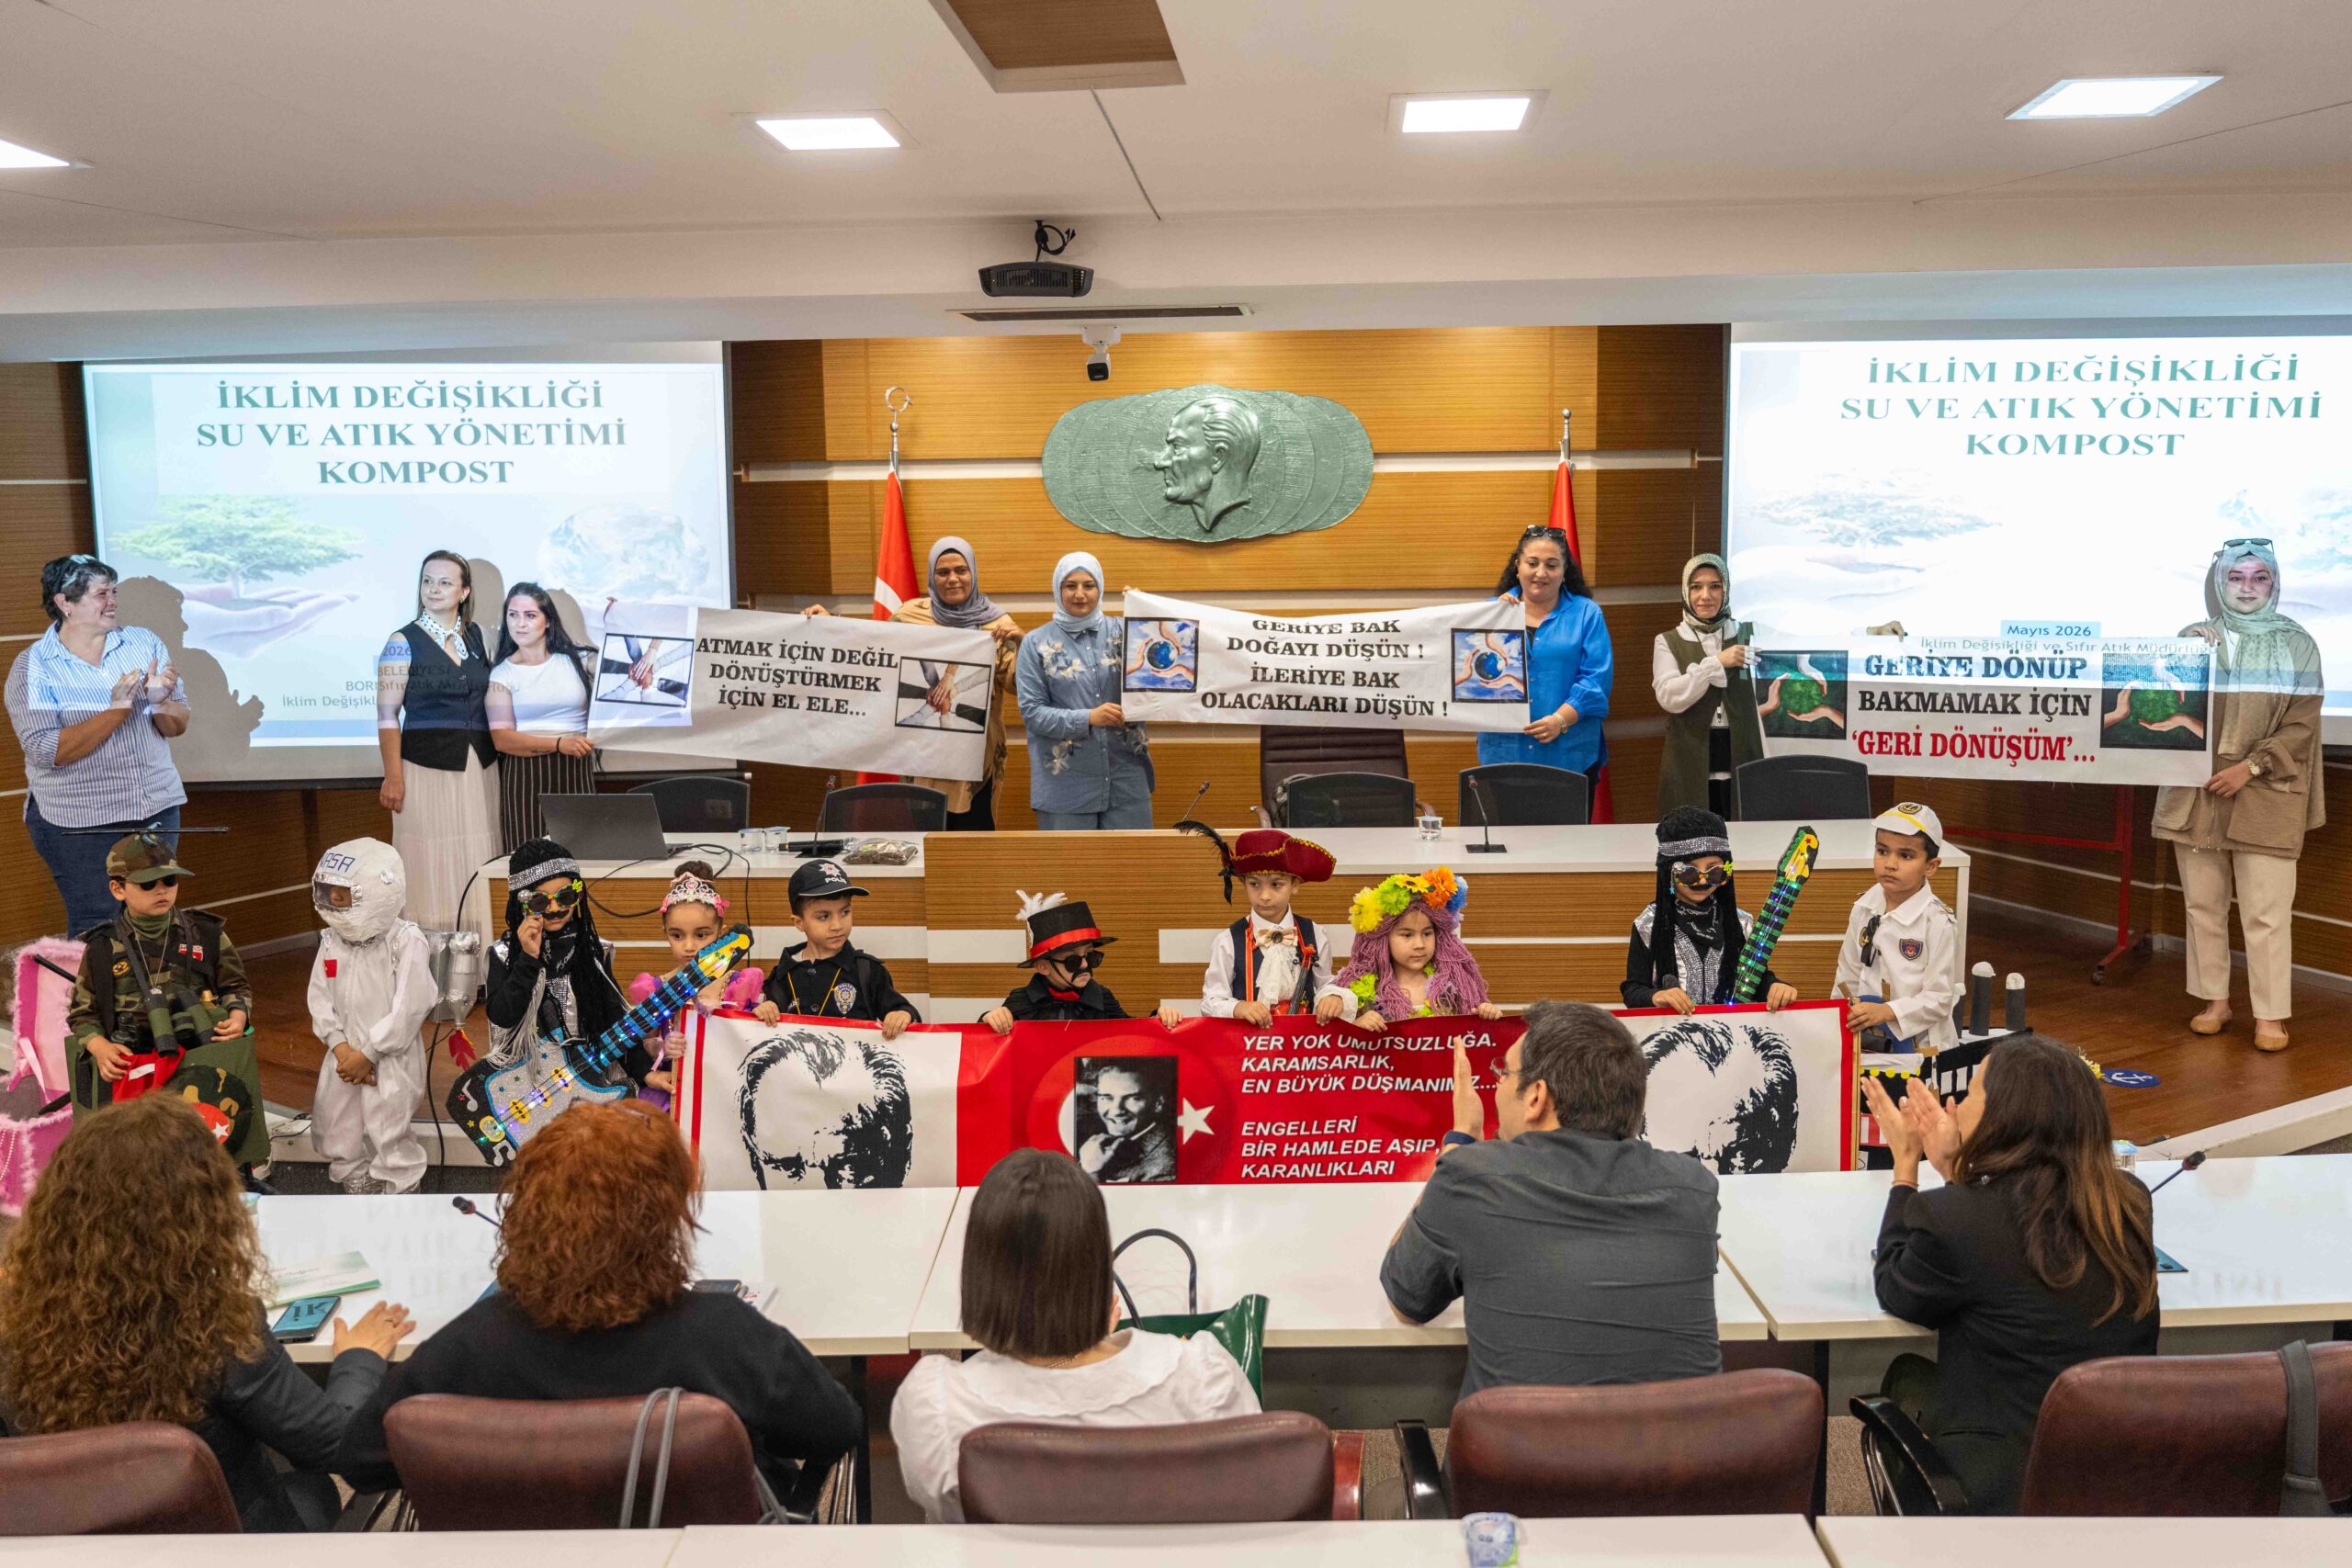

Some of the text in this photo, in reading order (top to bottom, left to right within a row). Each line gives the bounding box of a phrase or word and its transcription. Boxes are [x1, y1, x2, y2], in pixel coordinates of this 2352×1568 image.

[1868, 353, 2299, 387] İKLİM DEĞİŞİKLİĞİ
[217, 378, 603, 413] İKLİM DEĞİŞİKLİĞİ
[1840, 390, 2323, 420] SU VE ATIK YÖNETİMİ
[198, 417, 628, 446] SU VE ATIK YÖNETİMİ
[1966, 434, 2185, 457] KOMPOST
[318, 460, 514, 484] KOMPOST
[1252, 619, 1401, 634] GERİYE BAK
[2007, 625, 2091, 638] Mayıs 2026
[695, 637, 899, 669] ATMAK İÇİN DEĞİL
[1227, 635, 1319, 657] DOĞAYI
[1326, 638, 1410, 661] DÜŞÜN
[1921, 637, 1956, 649] İklim
[2042, 642, 2060, 651] ve
[2066, 639, 2098, 652] Sıfır
[2101, 642, 2131, 653] Atık
[709, 660, 881, 693] DÖNÜŞTÜRMEK
[1250, 661, 1400, 689] İLERİYE BAK
[1865, 649, 2087, 679] GERİYE DÖNÜP
[282, 694, 317, 706] İklim
[718, 684, 866, 716] İÇİN EL ELE...
[1200, 691, 1348, 714] OLACAKLARI
[1354, 694, 1434, 719] DÜŞÜN
[1858, 687, 2092, 722] BAKMAMAK İÇİN
[1242, 1035, 1284, 1051] YER
[1291, 1033, 1332, 1050] YOK
[1241, 1055, 1395, 1072] KARAMSARLIK,
[1241, 1078, 1271, 1093] EN
[1276, 1074, 1346, 1093] BÜYÜK
[1241, 1116, 1358, 1136] ENGELLERİ
[1241, 1138, 1441, 1157] BİR HAMLEDE AŞIP,
[1241, 1160, 1396, 1179] KARANLIKLARI
